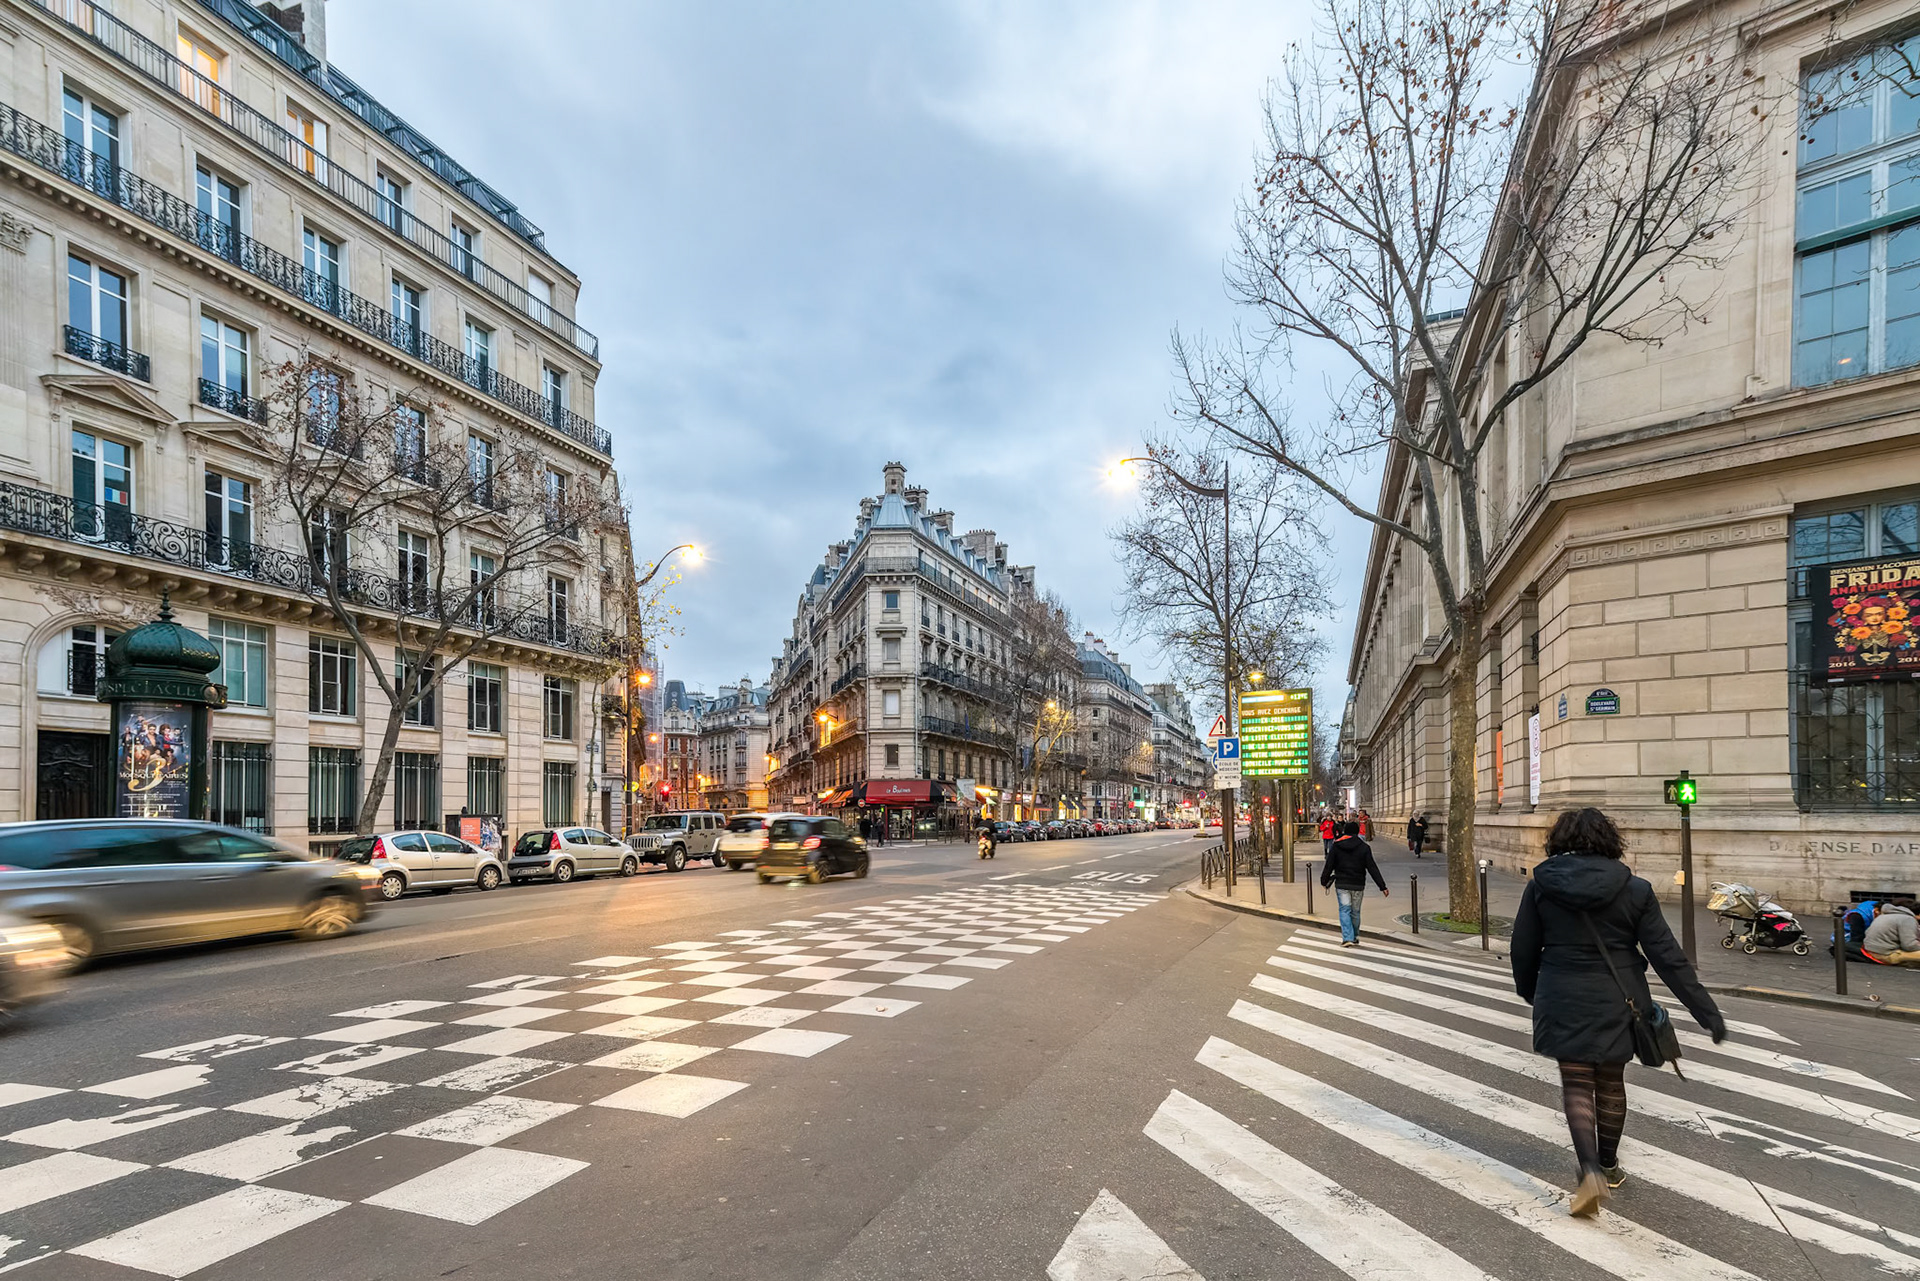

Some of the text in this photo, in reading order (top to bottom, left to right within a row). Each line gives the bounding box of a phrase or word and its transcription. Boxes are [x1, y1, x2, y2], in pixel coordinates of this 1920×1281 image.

[1830, 565, 1875, 575] BENJAMIN
[1830, 565, 1920, 589] FRIDA
[1828, 660, 1857, 668] 2016
[1897, 656, 1920, 664] 201
[1251, 733, 1268, 741] LISTE
[1223, 741, 1234, 756] P
[1070, 873, 1160, 884] BUS
